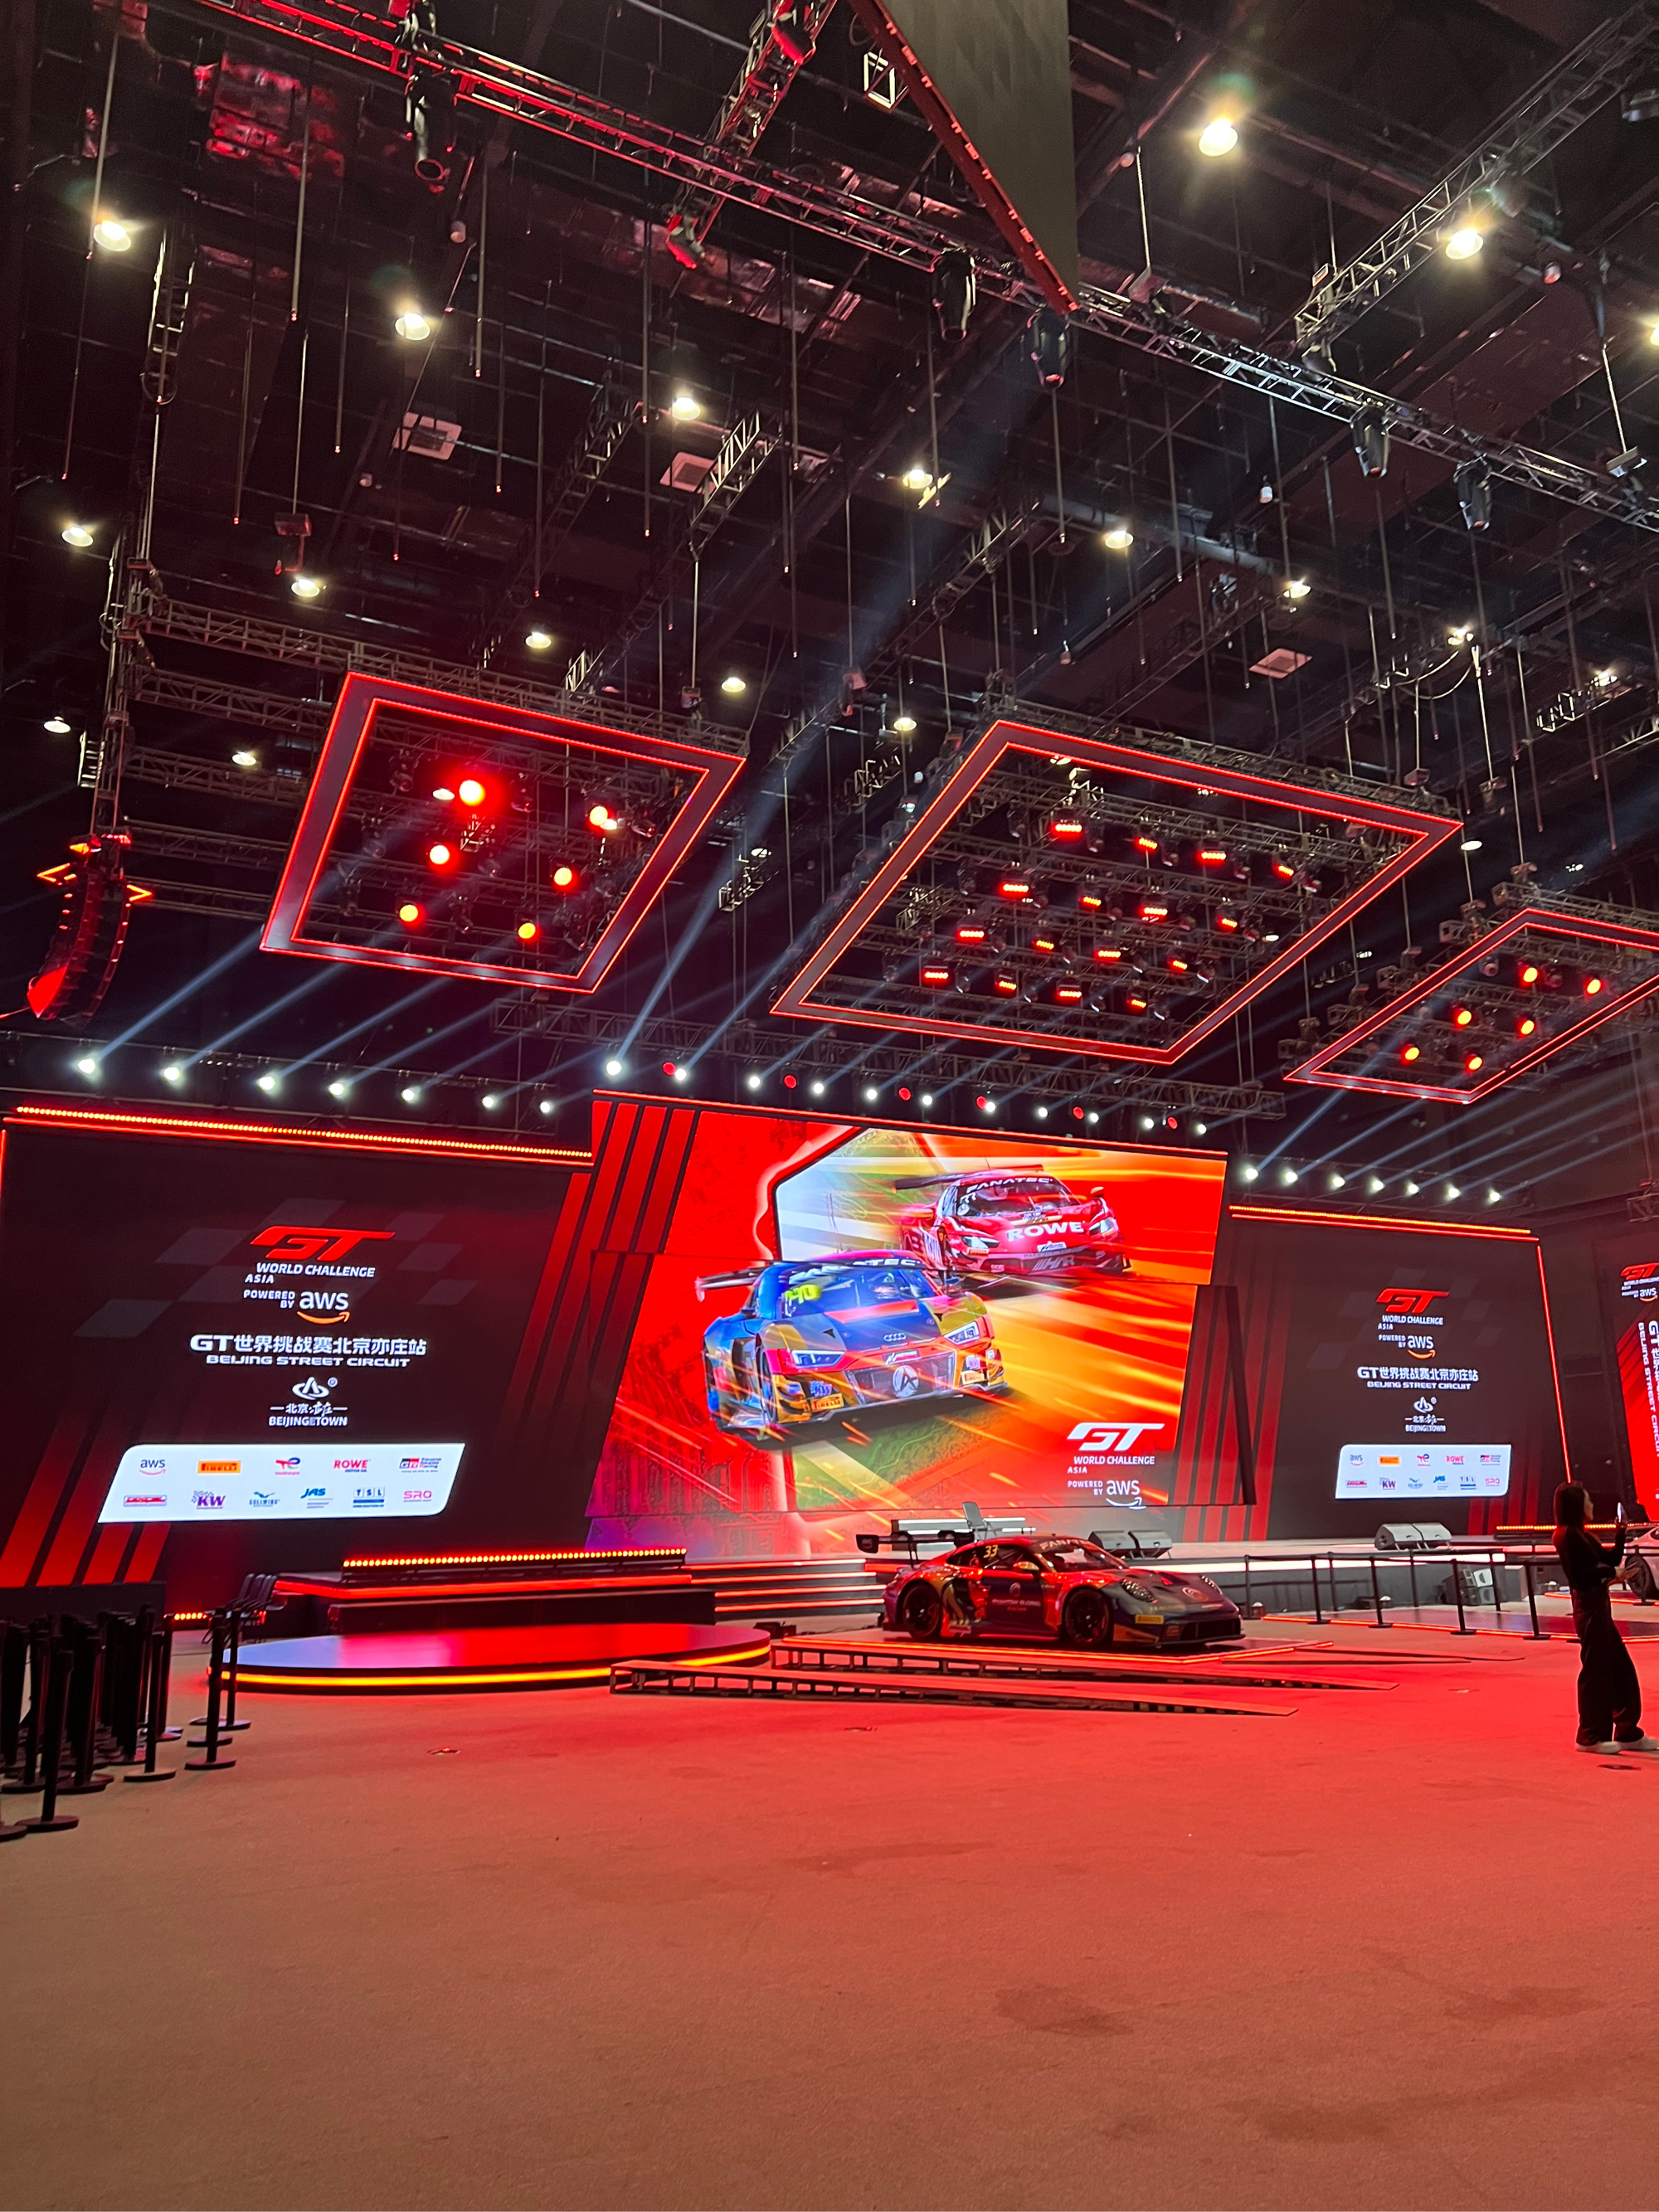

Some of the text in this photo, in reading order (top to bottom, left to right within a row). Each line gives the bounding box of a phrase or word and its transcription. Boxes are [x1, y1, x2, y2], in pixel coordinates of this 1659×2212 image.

[966, 1177, 1049, 1194] FANATEC
[1005, 1221, 1084, 1242] ROWE
[250, 1225, 397, 1262] GT
[256, 1262, 376, 1278] WORLD CHALLENGE
[244, 1274, 275, 1284] ASIA
[243, 1289, 296, 1300] POWERED
[1639, 1287, 1657, 1297] aws
[280, 1300, 295, 1309] BY
[299, 1291, 349, 1310] aws
[1376, 1287, 1449, 1315] GT
[1382, 1315, 1444, 1325] WORLD CHALLENGE
[189, 1334, 427, 1356] GT世界挑战赛北京亦庄站
[1407, 1335, 1434, 1349] aws
[206, 1354, 411, 1367] BEIJING STREET CIRCUIT
[1645, 1367, 1657, 1412] STREET
[1067, 1422, 1165, 1451] GT
[140, 1459, 166, 1468] aws
[333, 1459, 368, 1469] ROWE
[1073, 1456, 1155, 1465] WORLD CHALLENGE
[1106, 1480, 1141, 1495] aws
[1382, 1480, 1396, 1489] KW
[300, 1488, 326, 1500] JAS
[403, 1490, 432, 1500] SRO
[197, 1495, 226, 1507] KW
[983, 1544, 999, 1558] 33
